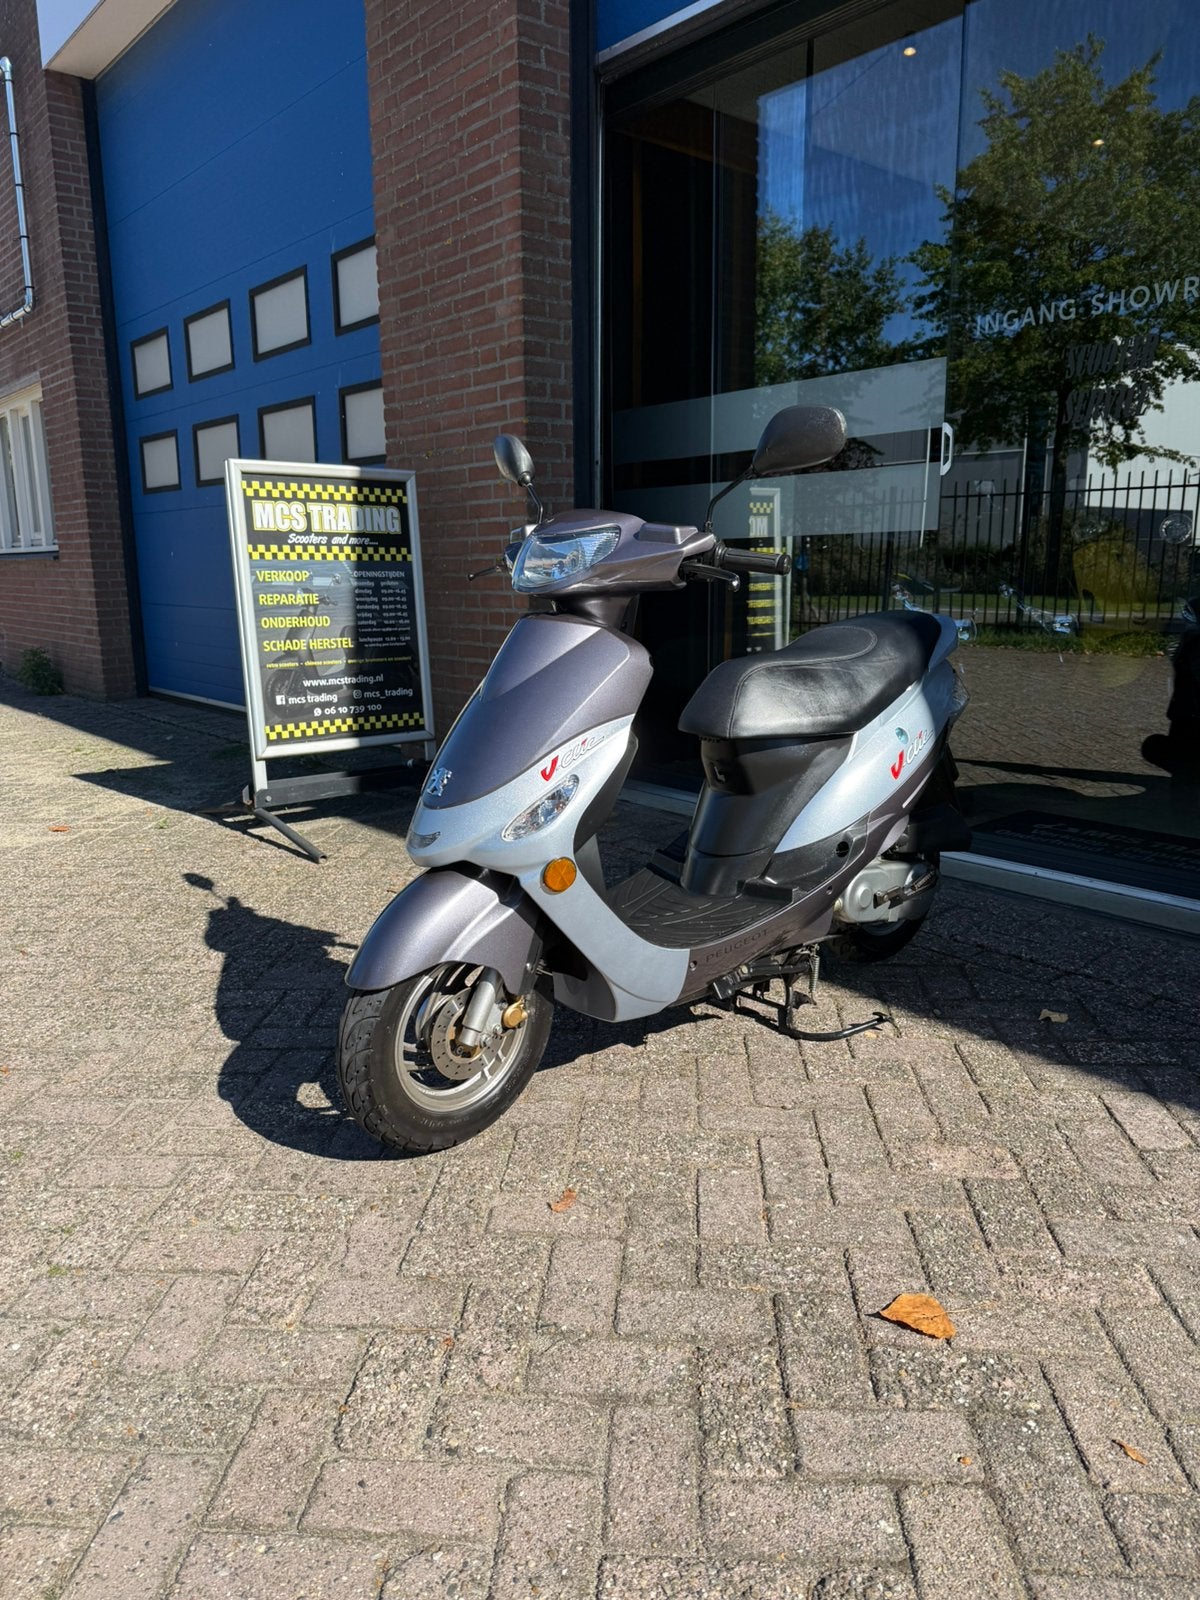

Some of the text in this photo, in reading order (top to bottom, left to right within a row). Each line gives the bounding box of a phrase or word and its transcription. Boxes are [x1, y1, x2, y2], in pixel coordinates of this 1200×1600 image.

[974, 298, 1076, 336] INGANG
[252, 500, 401, 534] MCS TRADING
[288, 533, 328, 545] Scooters
[331, 534, 348, 545] and
[256, 570, 310, 582] VERKOOP
[258, 593, 320, 605] REPARATIE
[261, 615, 331, 628] ONDERHOUD
[263, 638, 307, 652] SCHADE
[309, 637, 354, 650] HERSTEL
[302, 674, 384, 687] www.mcstrading.nl
[307, 693, 338, 703] trading
[363, 687, 413, 699] mcs_trading
[324, 706, 336, 715] 06
[338, 706, 348, 714] 10
[349, 705, 365, 714] 739
[705, 929, 769, 962] PEUGEOT
